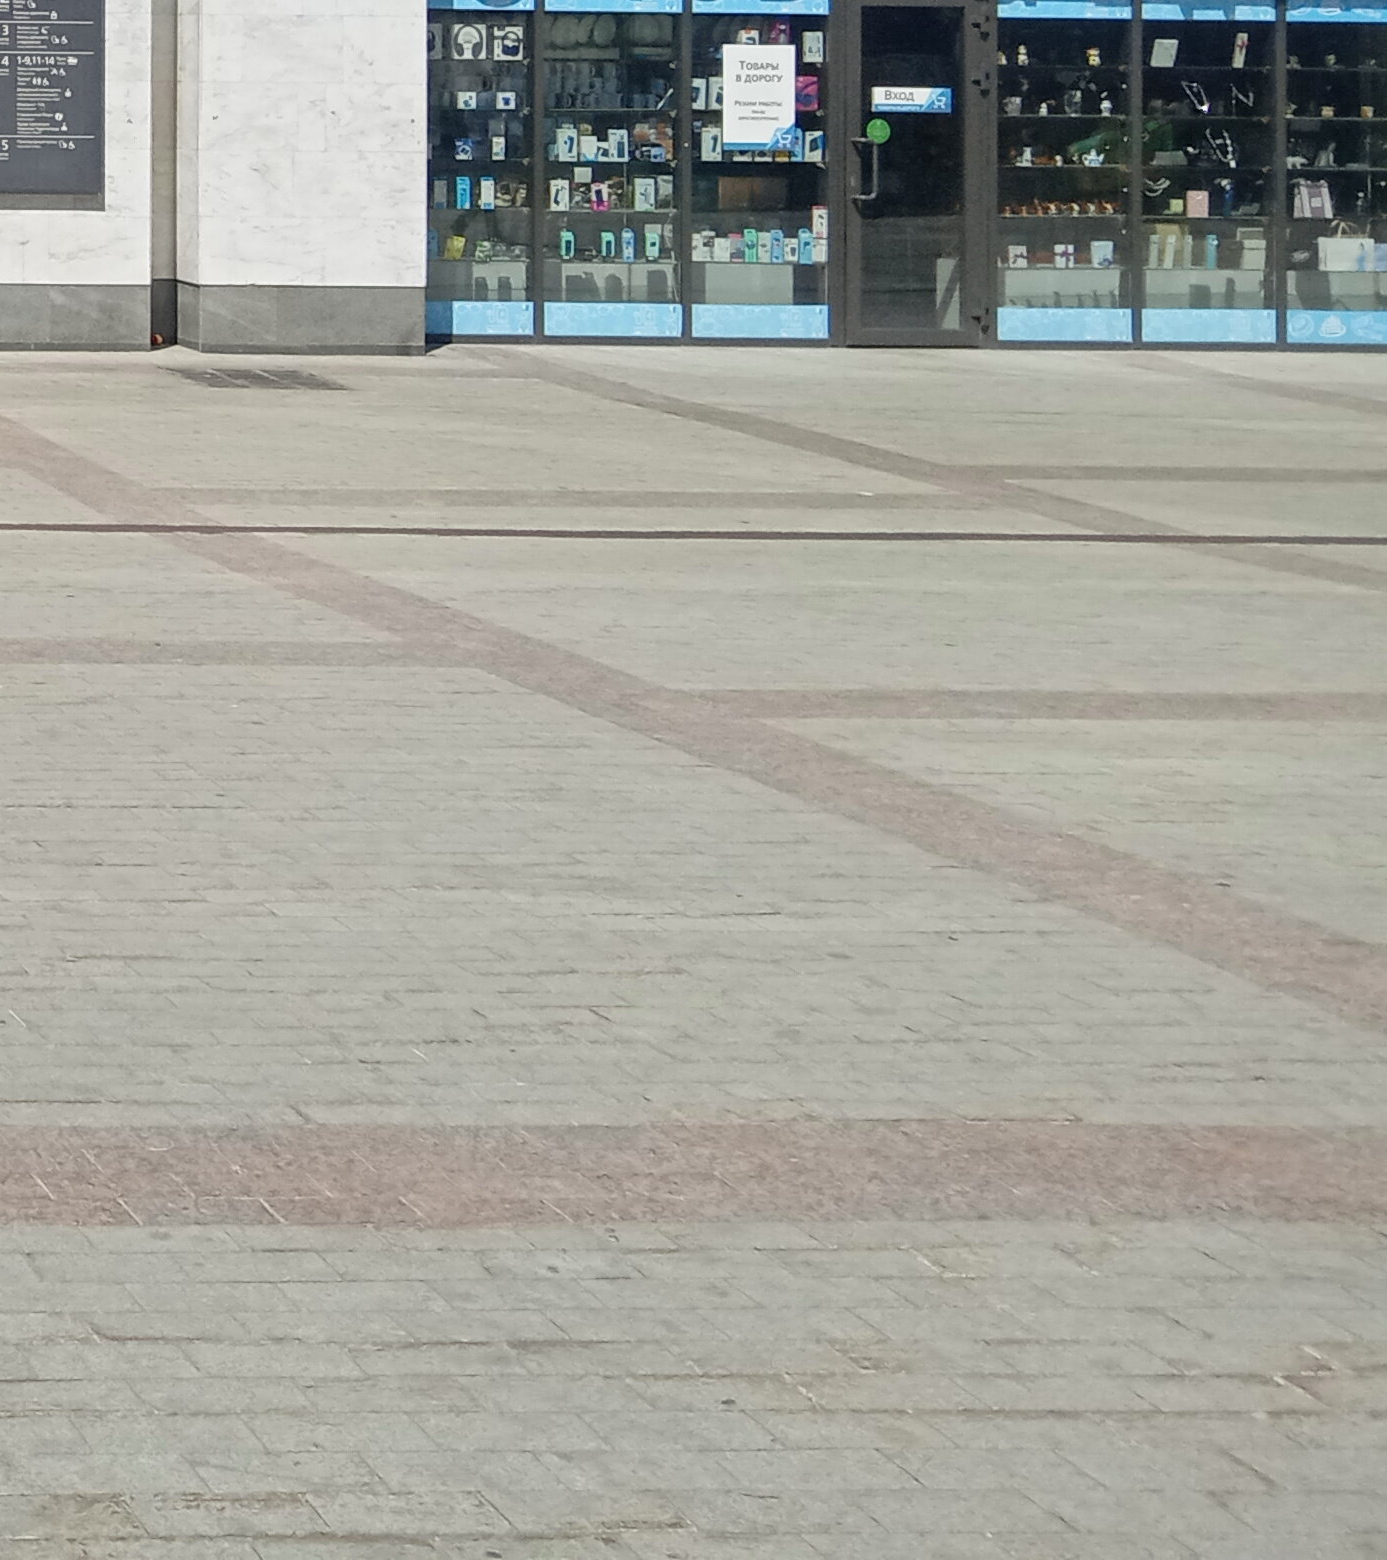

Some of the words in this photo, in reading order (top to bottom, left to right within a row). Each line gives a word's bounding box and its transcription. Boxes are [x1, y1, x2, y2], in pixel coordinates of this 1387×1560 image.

[1, 24, 9, 36] 3
[0, 55, 10, 67] 4
[1, 139, 9, 151] 5
